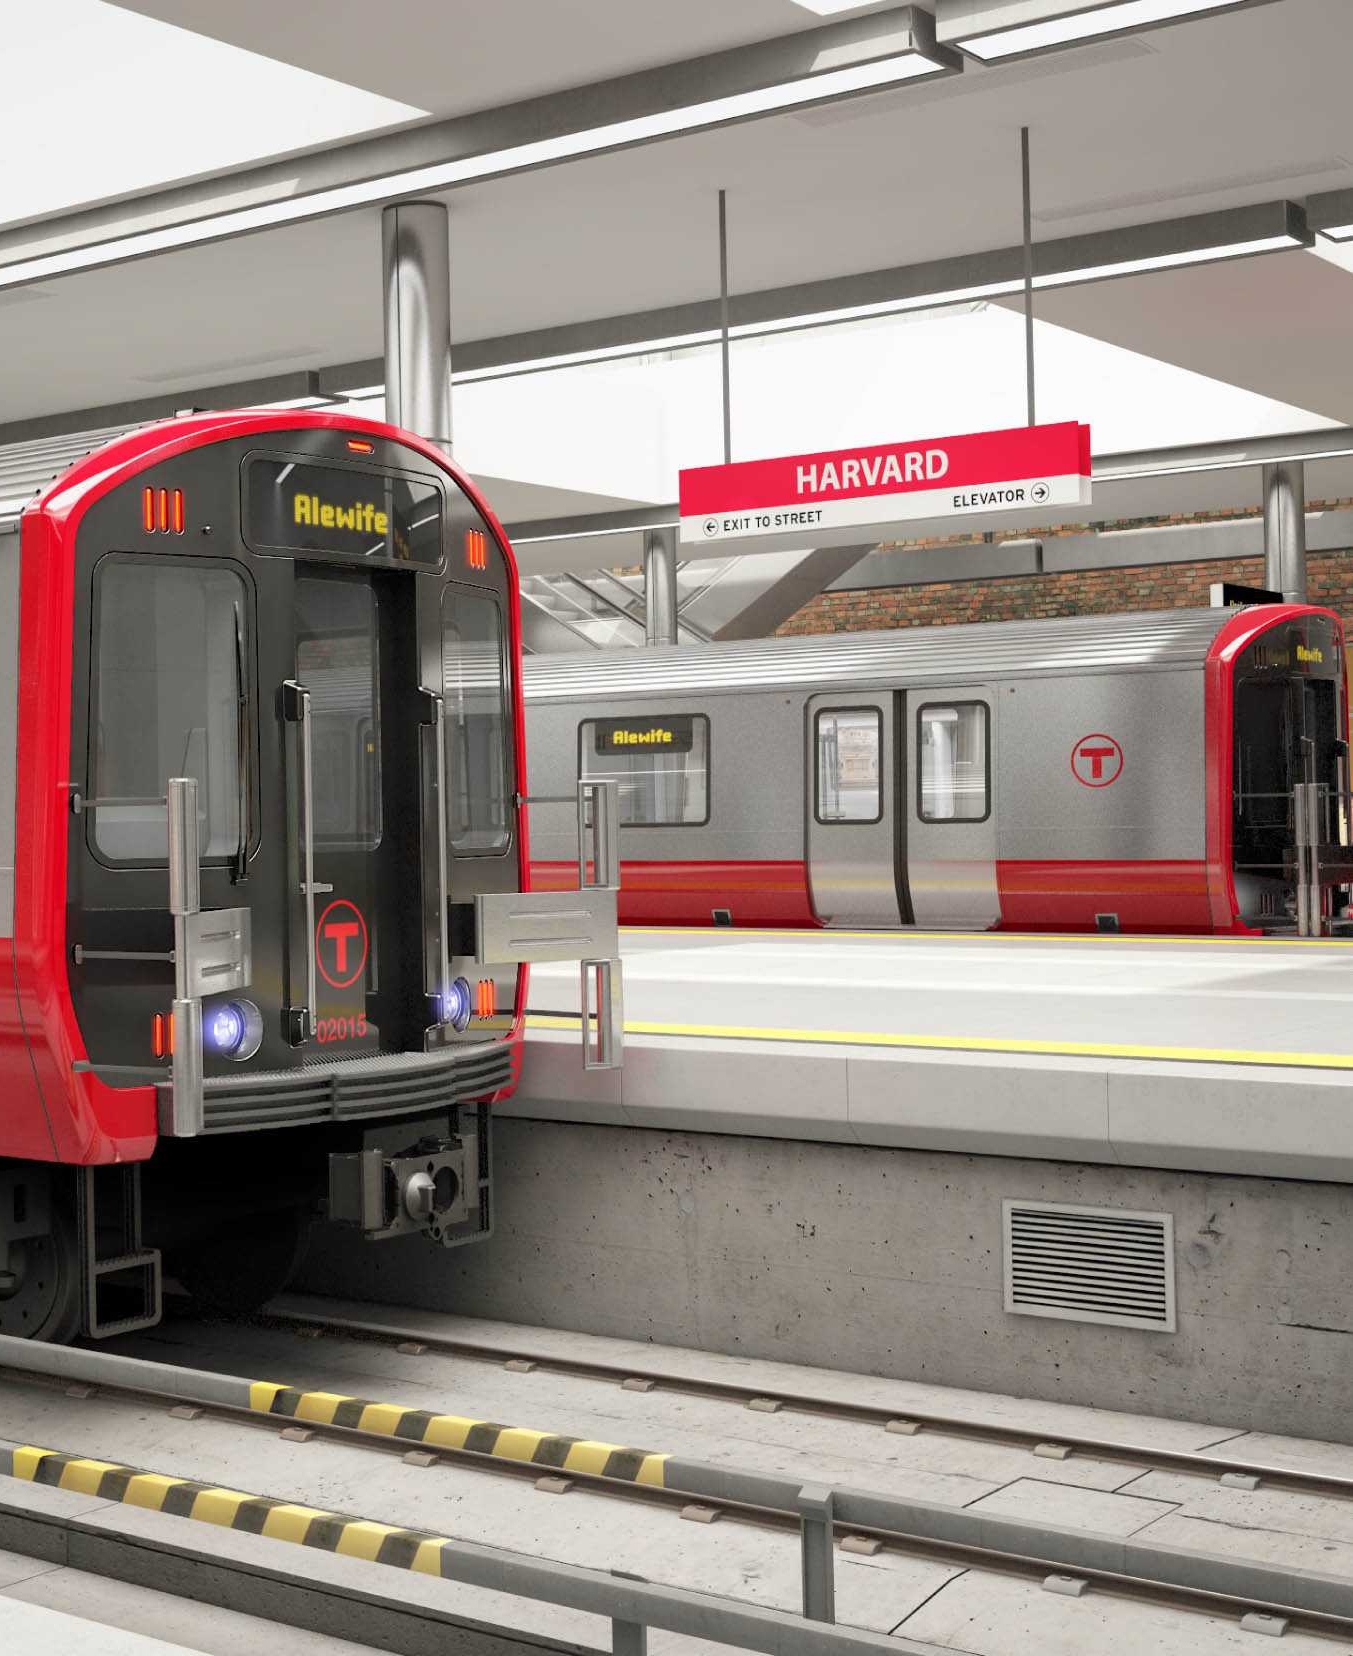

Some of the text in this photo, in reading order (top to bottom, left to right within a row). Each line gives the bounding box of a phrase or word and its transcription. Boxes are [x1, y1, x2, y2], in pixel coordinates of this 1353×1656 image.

[795, 448, 949, 495] HARVARD
[953, 488, 1025, 508] ELEVATOR
[294, 494, 388, 534] Alewife
[723, 510, 823, 531] EXIT TO STREET
[1296, 645, 1323, 662] Alewife
[613, 728, 672, 745] Alewife
[1080, 747, 1115, 778] T
[324, 921, 359, 973] T
[317, 1013, 366, 1043] 02015
